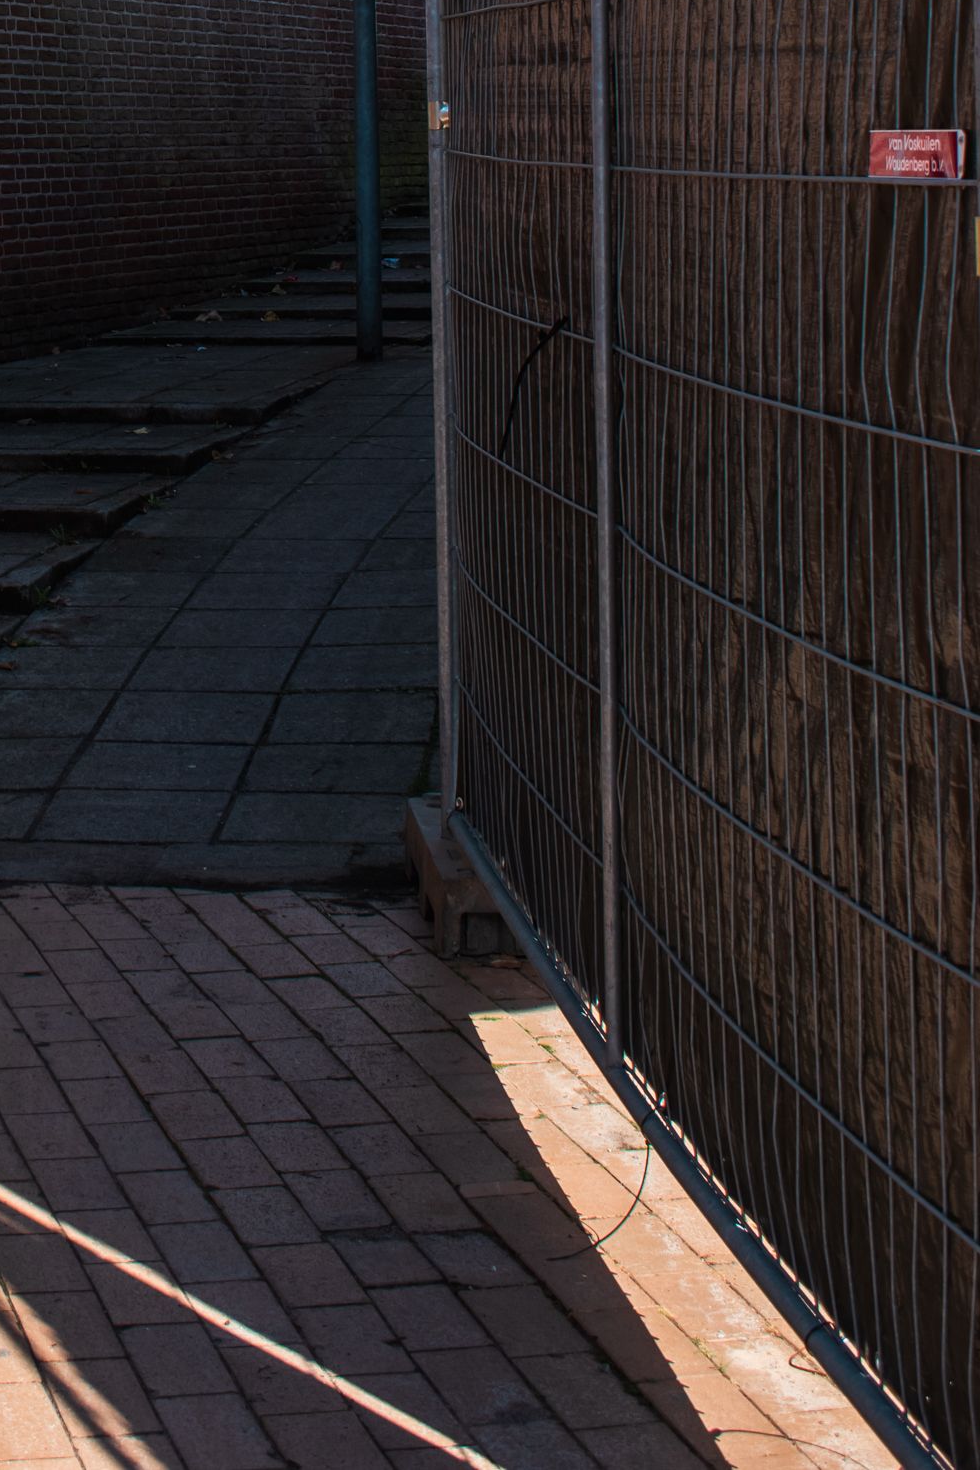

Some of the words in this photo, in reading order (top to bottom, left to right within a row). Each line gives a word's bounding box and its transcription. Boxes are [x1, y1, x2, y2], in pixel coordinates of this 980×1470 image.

[888, 138, 902, 151] van
[903, 134, 941, 151] Voskuilen
[885, 155, 930, 176] Woudenberg
